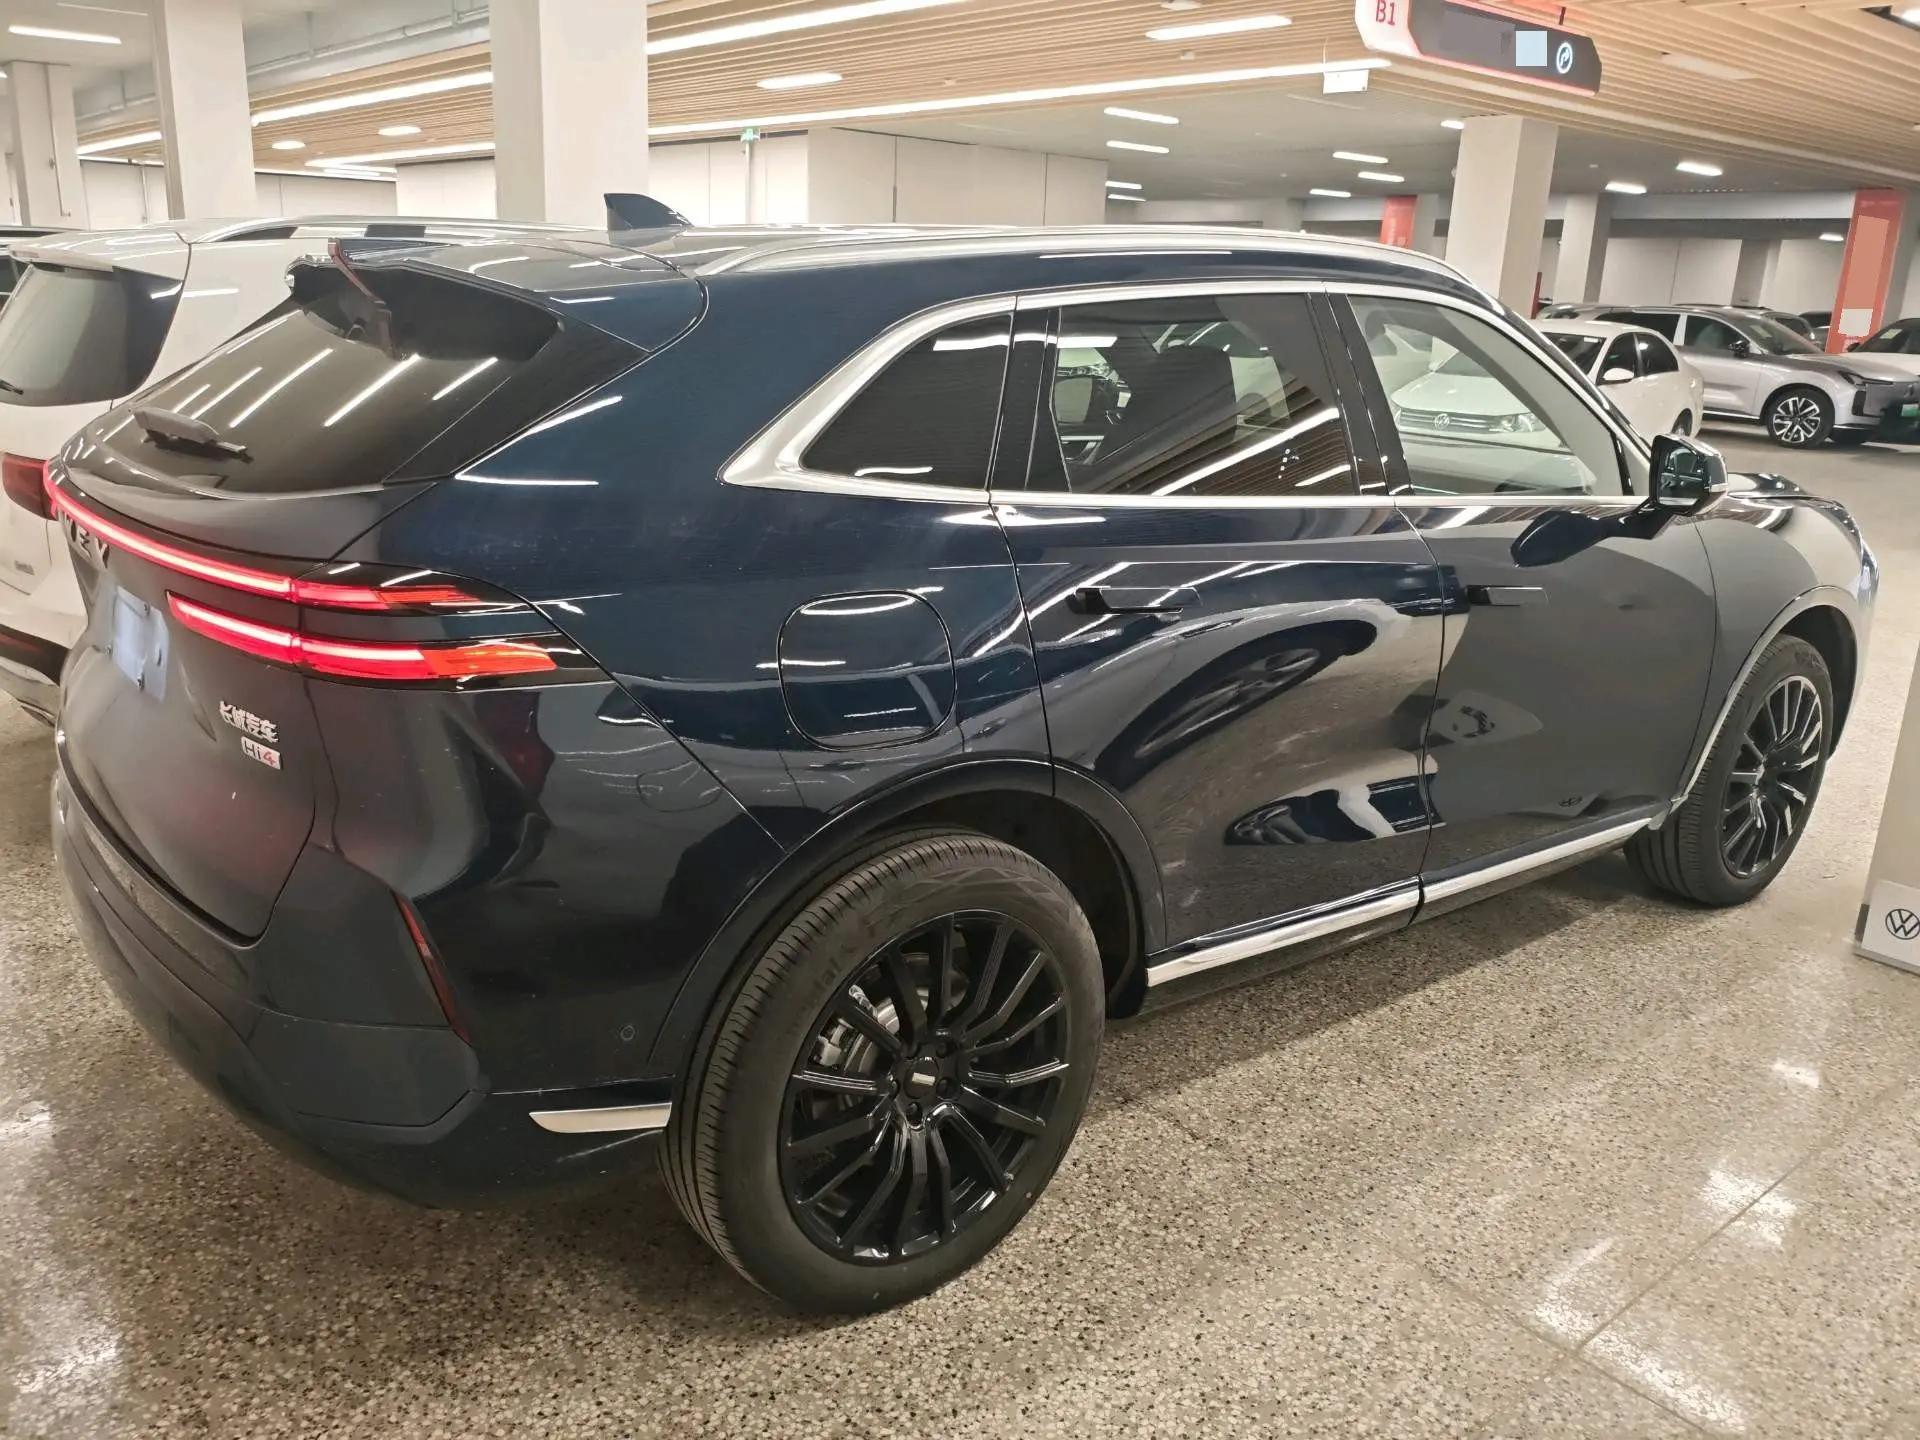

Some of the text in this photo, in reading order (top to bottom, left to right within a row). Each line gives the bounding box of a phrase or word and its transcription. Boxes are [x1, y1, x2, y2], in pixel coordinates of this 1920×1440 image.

[1376, 0, 1395, 26] B1
[219, 701, 279, 743] 长城汽车
[243, 740, 277, 766] Hi4
